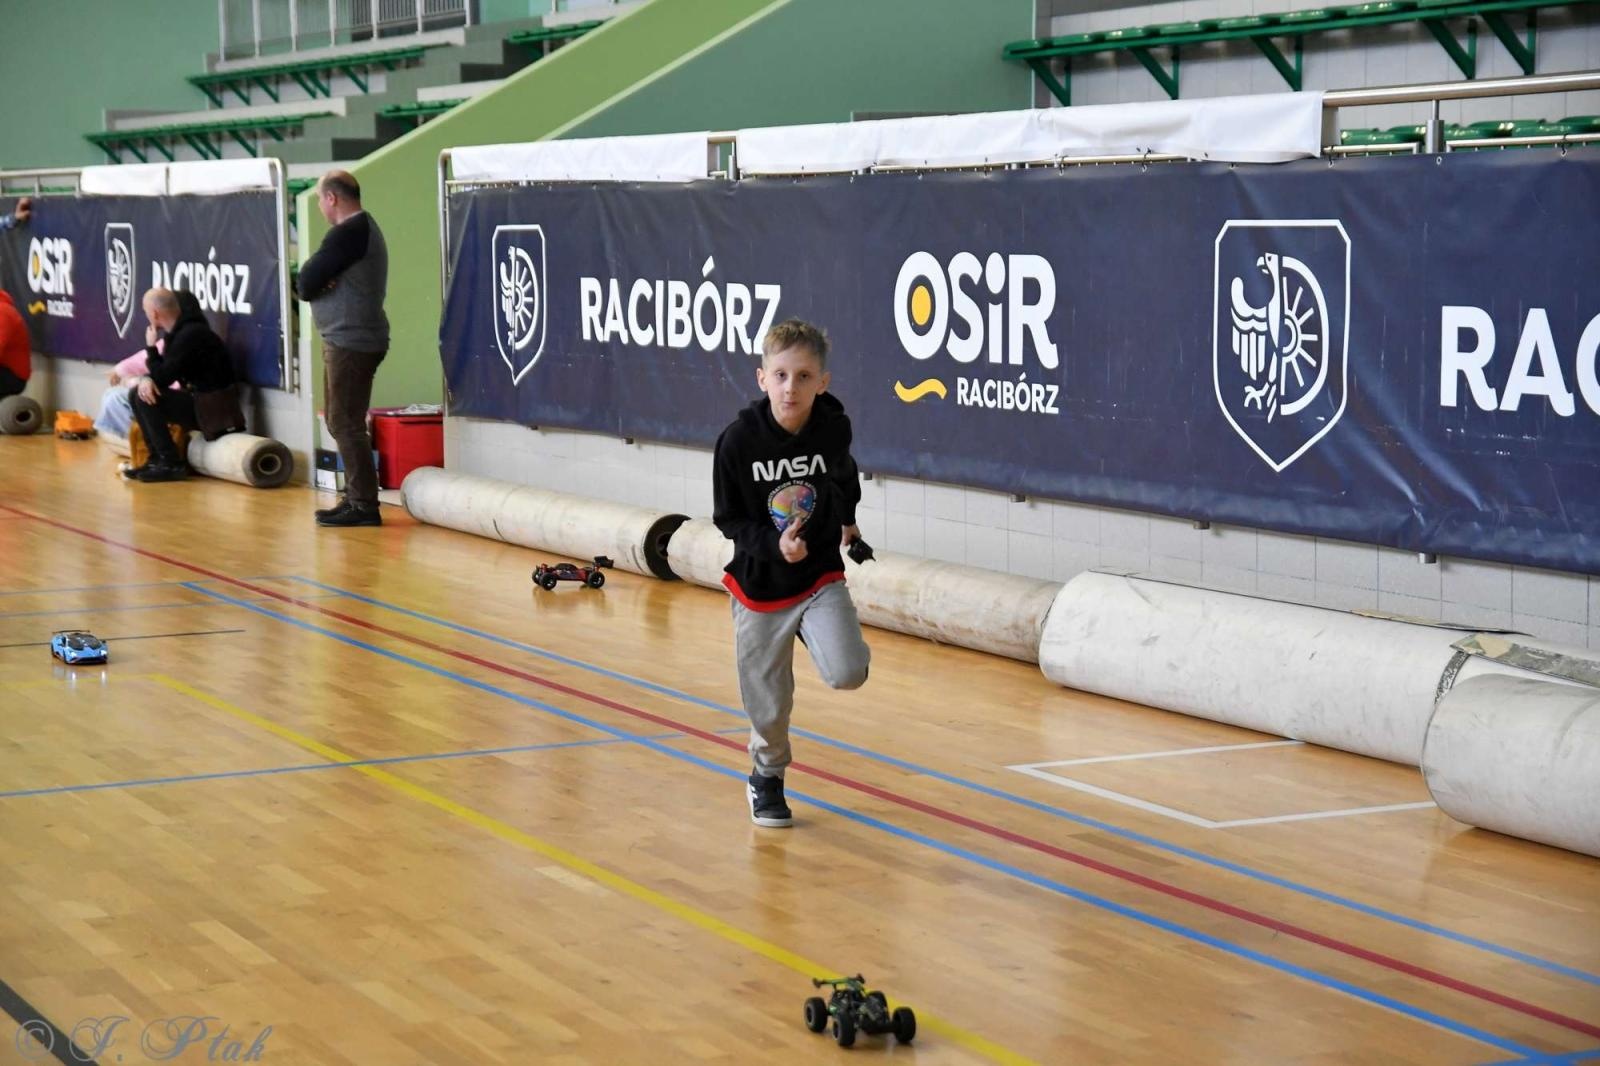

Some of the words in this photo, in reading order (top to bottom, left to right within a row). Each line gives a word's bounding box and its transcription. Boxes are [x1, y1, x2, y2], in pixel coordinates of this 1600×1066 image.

[580, 255, 782, 355] RACIBÓRZ
[956, 372, 1059, 415] RACIBÓRZ
[752, 454, 827, 482] NASA
